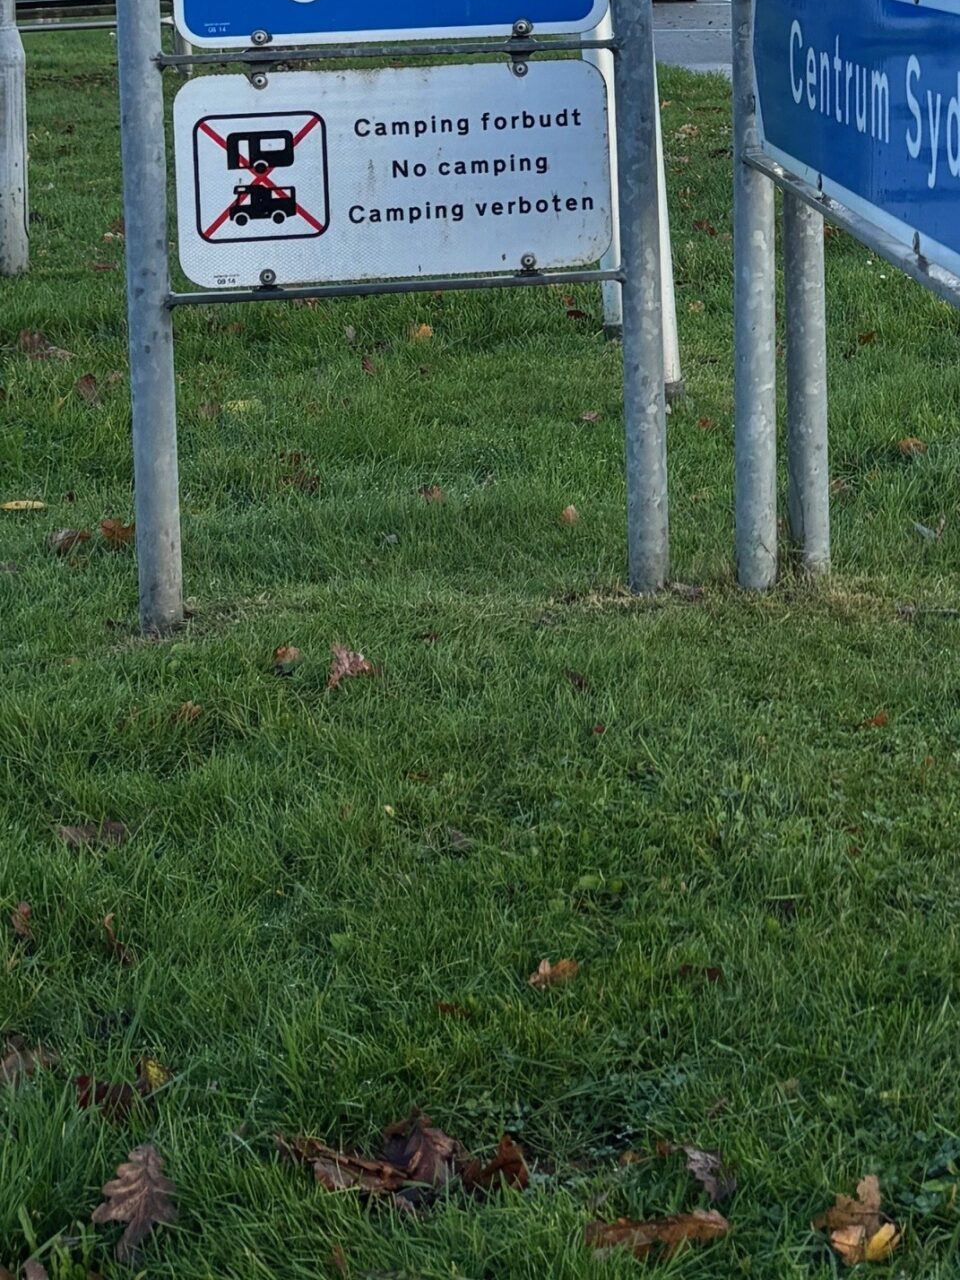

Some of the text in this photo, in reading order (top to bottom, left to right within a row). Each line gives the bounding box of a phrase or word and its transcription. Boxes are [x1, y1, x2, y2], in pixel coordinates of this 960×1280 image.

[790, 20, 889, 144] Centrum
[354, 108, 582, 138] Camping forbudt
[392, 154, 549, 179] No camping
[348, 194, 595, 224] Camping verboten
